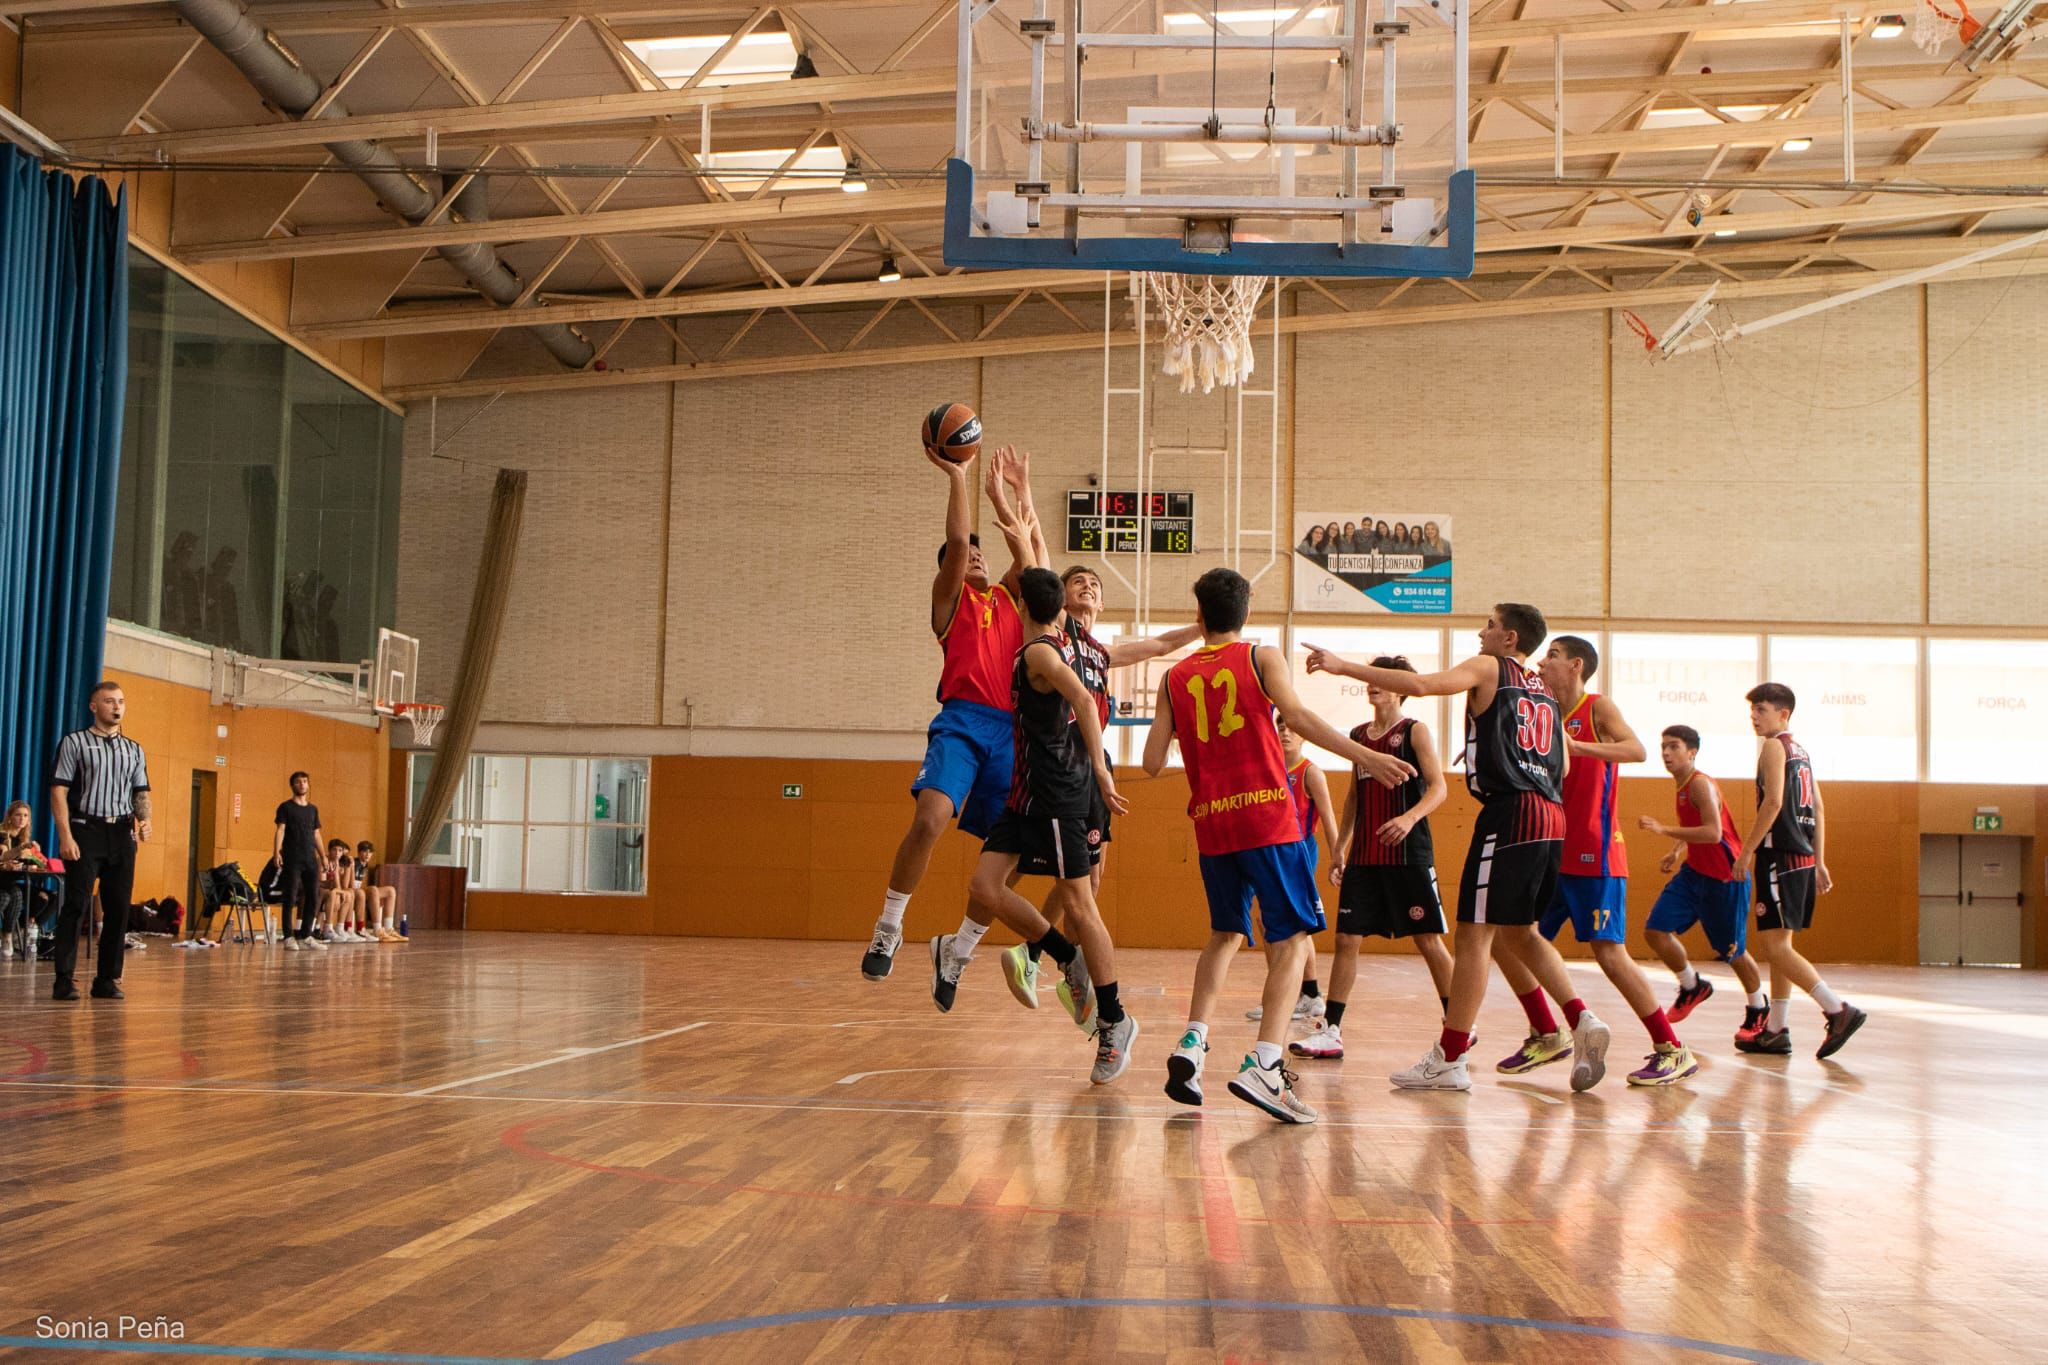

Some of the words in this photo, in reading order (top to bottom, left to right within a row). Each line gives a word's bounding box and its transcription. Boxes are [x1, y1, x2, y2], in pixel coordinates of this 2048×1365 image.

[1079, 519, 1103, 530] LOCA
[1152, 520, 1188, 531] VISITANTE
[1167, 531, 1188, 551] 18
[1328, 557, 1337, 569] TU
[1339, 557, 1372, 570] DENTISTA
[1373, 557, 1383, 570] DE
[1384, 557, 1423, 570] CONFIANZA
[1186, 667, 1246, 744] 12
[1658, 690, 1709, 706] FORÇA
[1976, 695, 2028, 712] FORÇA
[1515, 697, 1555, 757] 30
[1210, 786, 1287, 814] MARTINENC
[1592, 908, 1611, 931] 17
